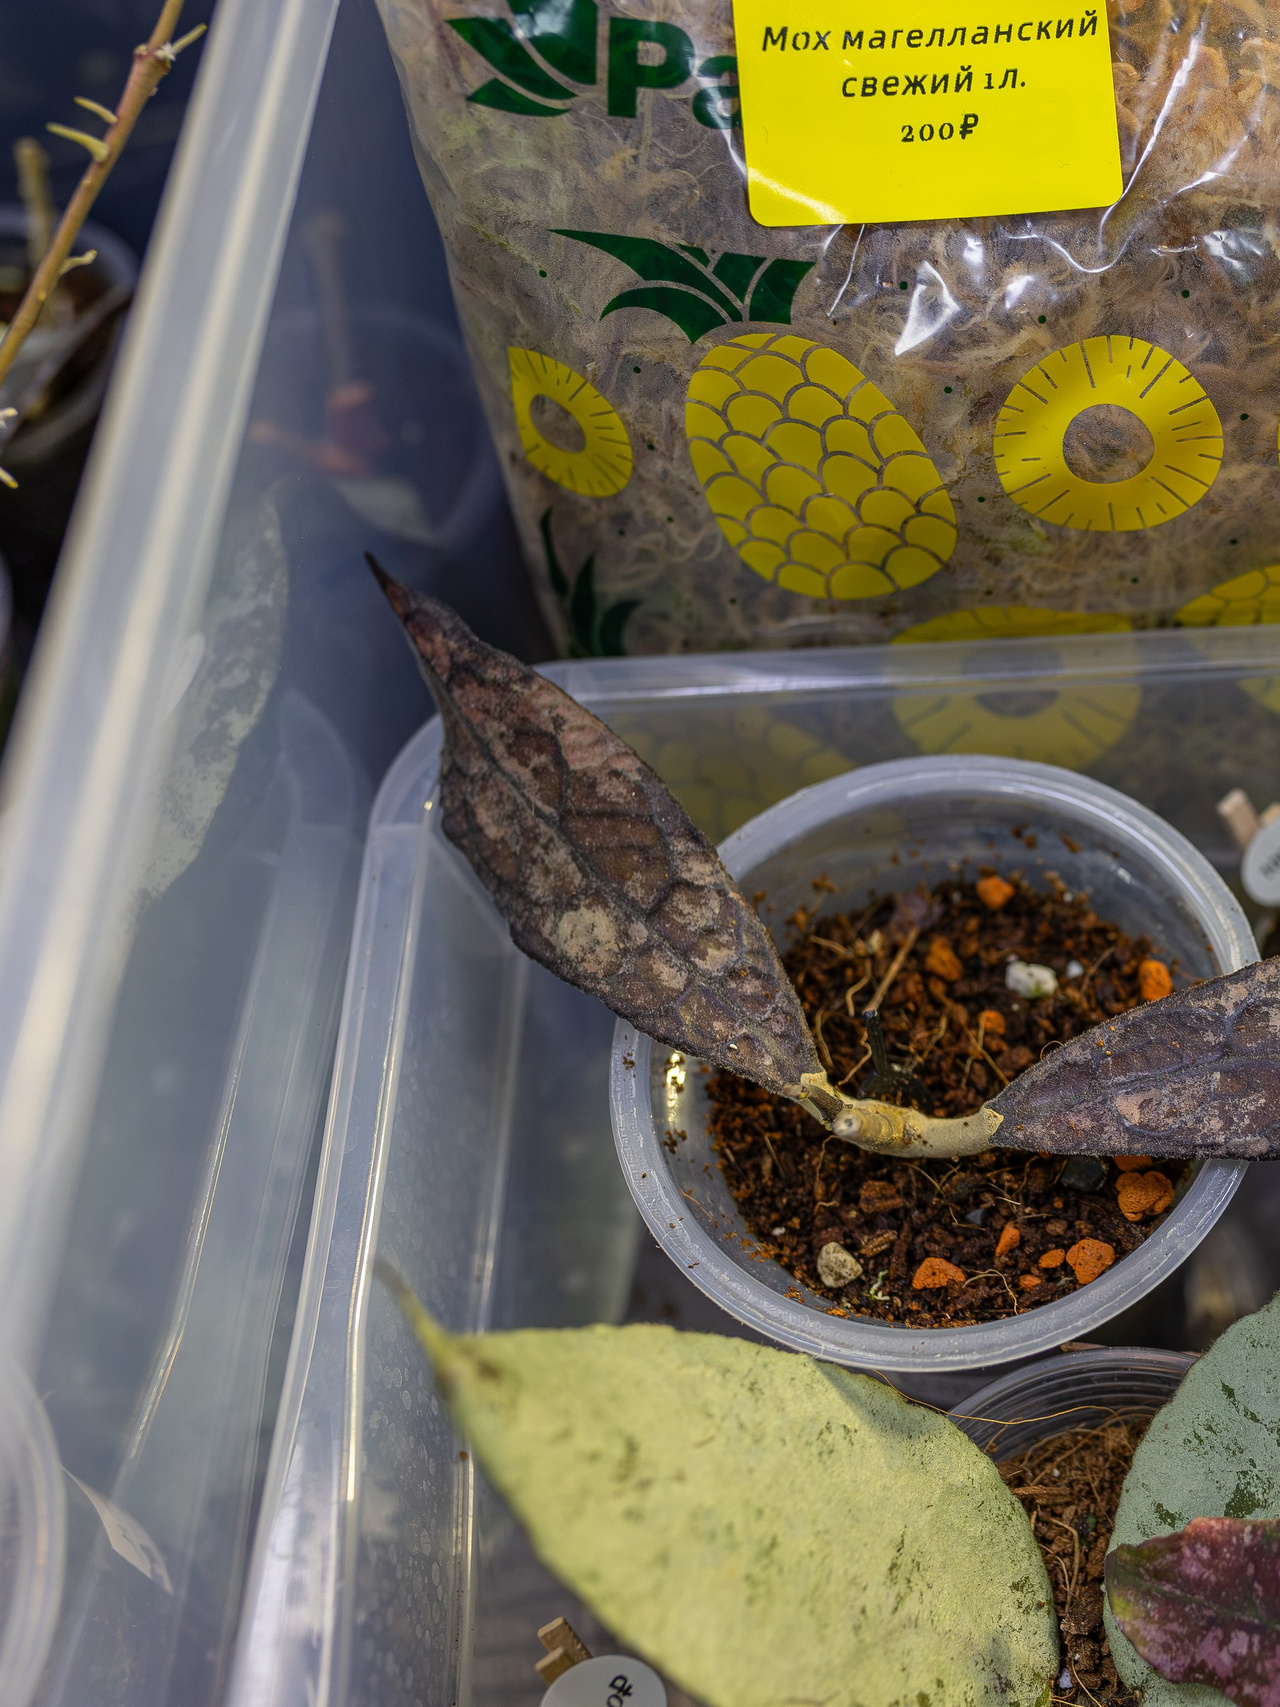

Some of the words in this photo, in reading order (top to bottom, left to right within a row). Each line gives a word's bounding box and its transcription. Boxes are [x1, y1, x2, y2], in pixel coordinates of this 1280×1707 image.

[762, 26, 830, 52] Мох
[842, 9, 1098, 50] магелланский
[841, 65, 972, 98] свежий
[983, 67, 1026, 90] 1л.
[901, 113, 979, 143] 200₽
